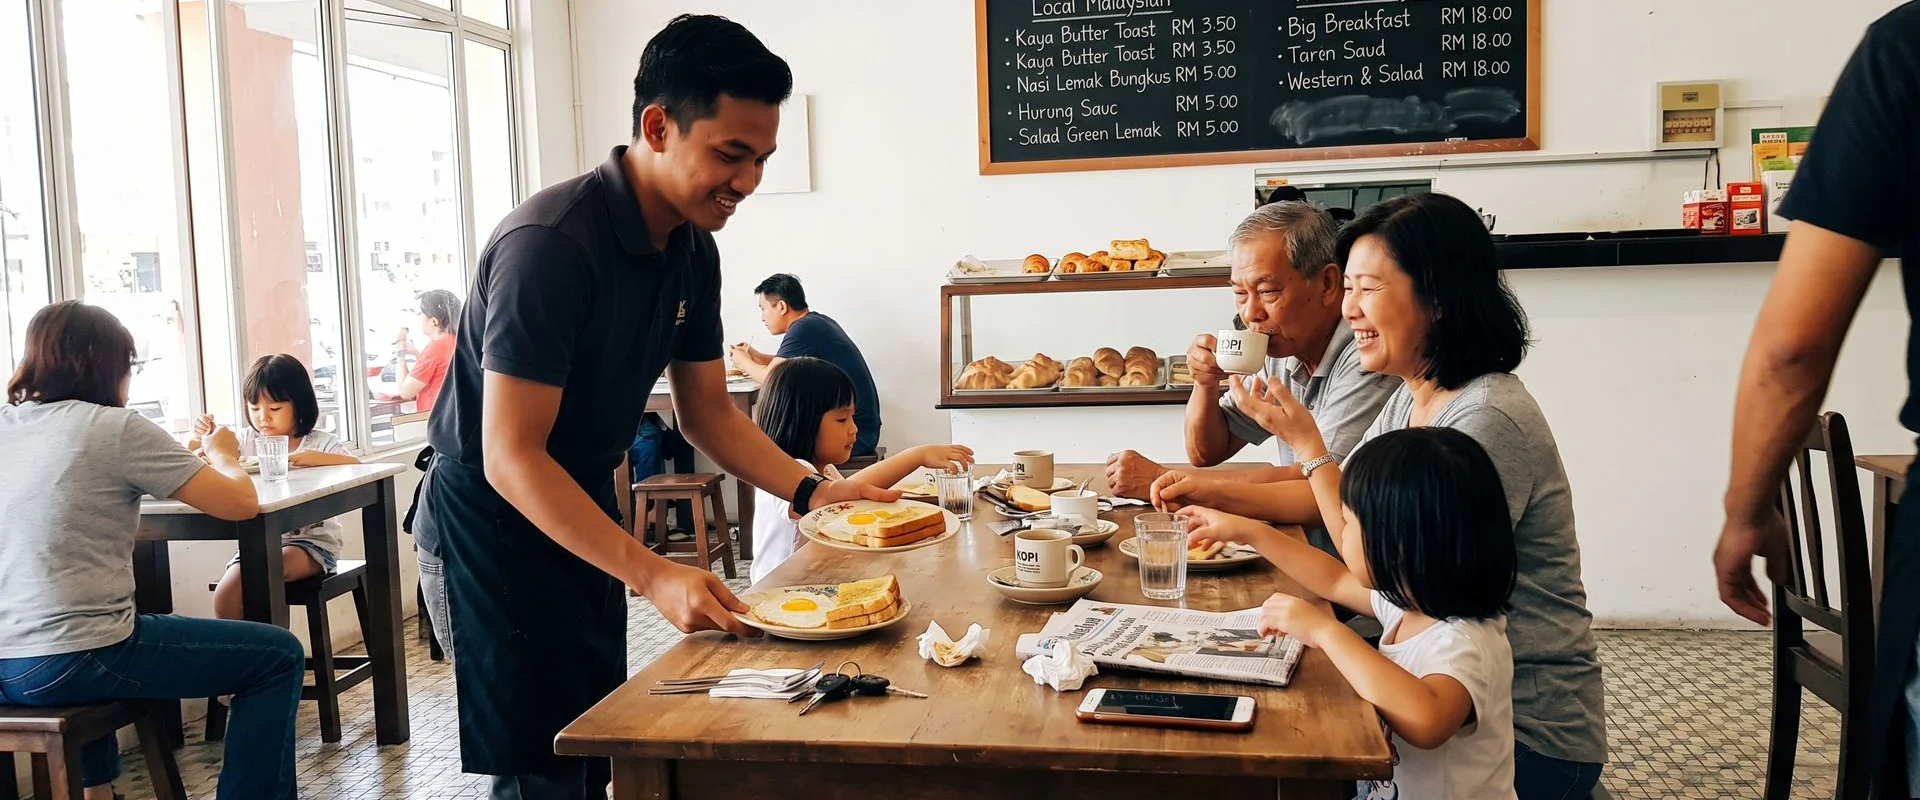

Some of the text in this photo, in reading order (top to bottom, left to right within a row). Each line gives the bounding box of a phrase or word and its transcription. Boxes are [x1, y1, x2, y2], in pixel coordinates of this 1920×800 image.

[1032, 0, 1076, 17] Local
[1441, 5, 1512, 25] RM 18.00
[1171, 15, 1236, 36] RM 3.50
[1288, 8, 1411, 42] Big Breakfast
[1015, 19, 1157, 52] Kaya Butter Toast
[1442, 32, 1512, 51] RM 18.00
[1172, 39, 1236, 59] RM 3.50
[1343, 38, 1386, 60] Saud
[1016, 43, 1156, 76] Kaya Butter Toast
[1442, 59, 1511, 79] RM 18.00
[1017, 67, 1171, 94] Nasi Lemak Bungkus
[1175, 64, 1237, 83] RM 5.00
[1287, 62, 1424, 91] Western & Salad
[1018, 98, 1118, 126] Hurung Sauc
[1175, 94, 1238, 113] RM 5.00
[1018, 120, 1162, 146] Salad Green Lemak
[1177, 119, 1239, 138] RM 5.00
[1219, 339, 1242, 351] OPI
[1016, 550, 1038, 562] KOPI
